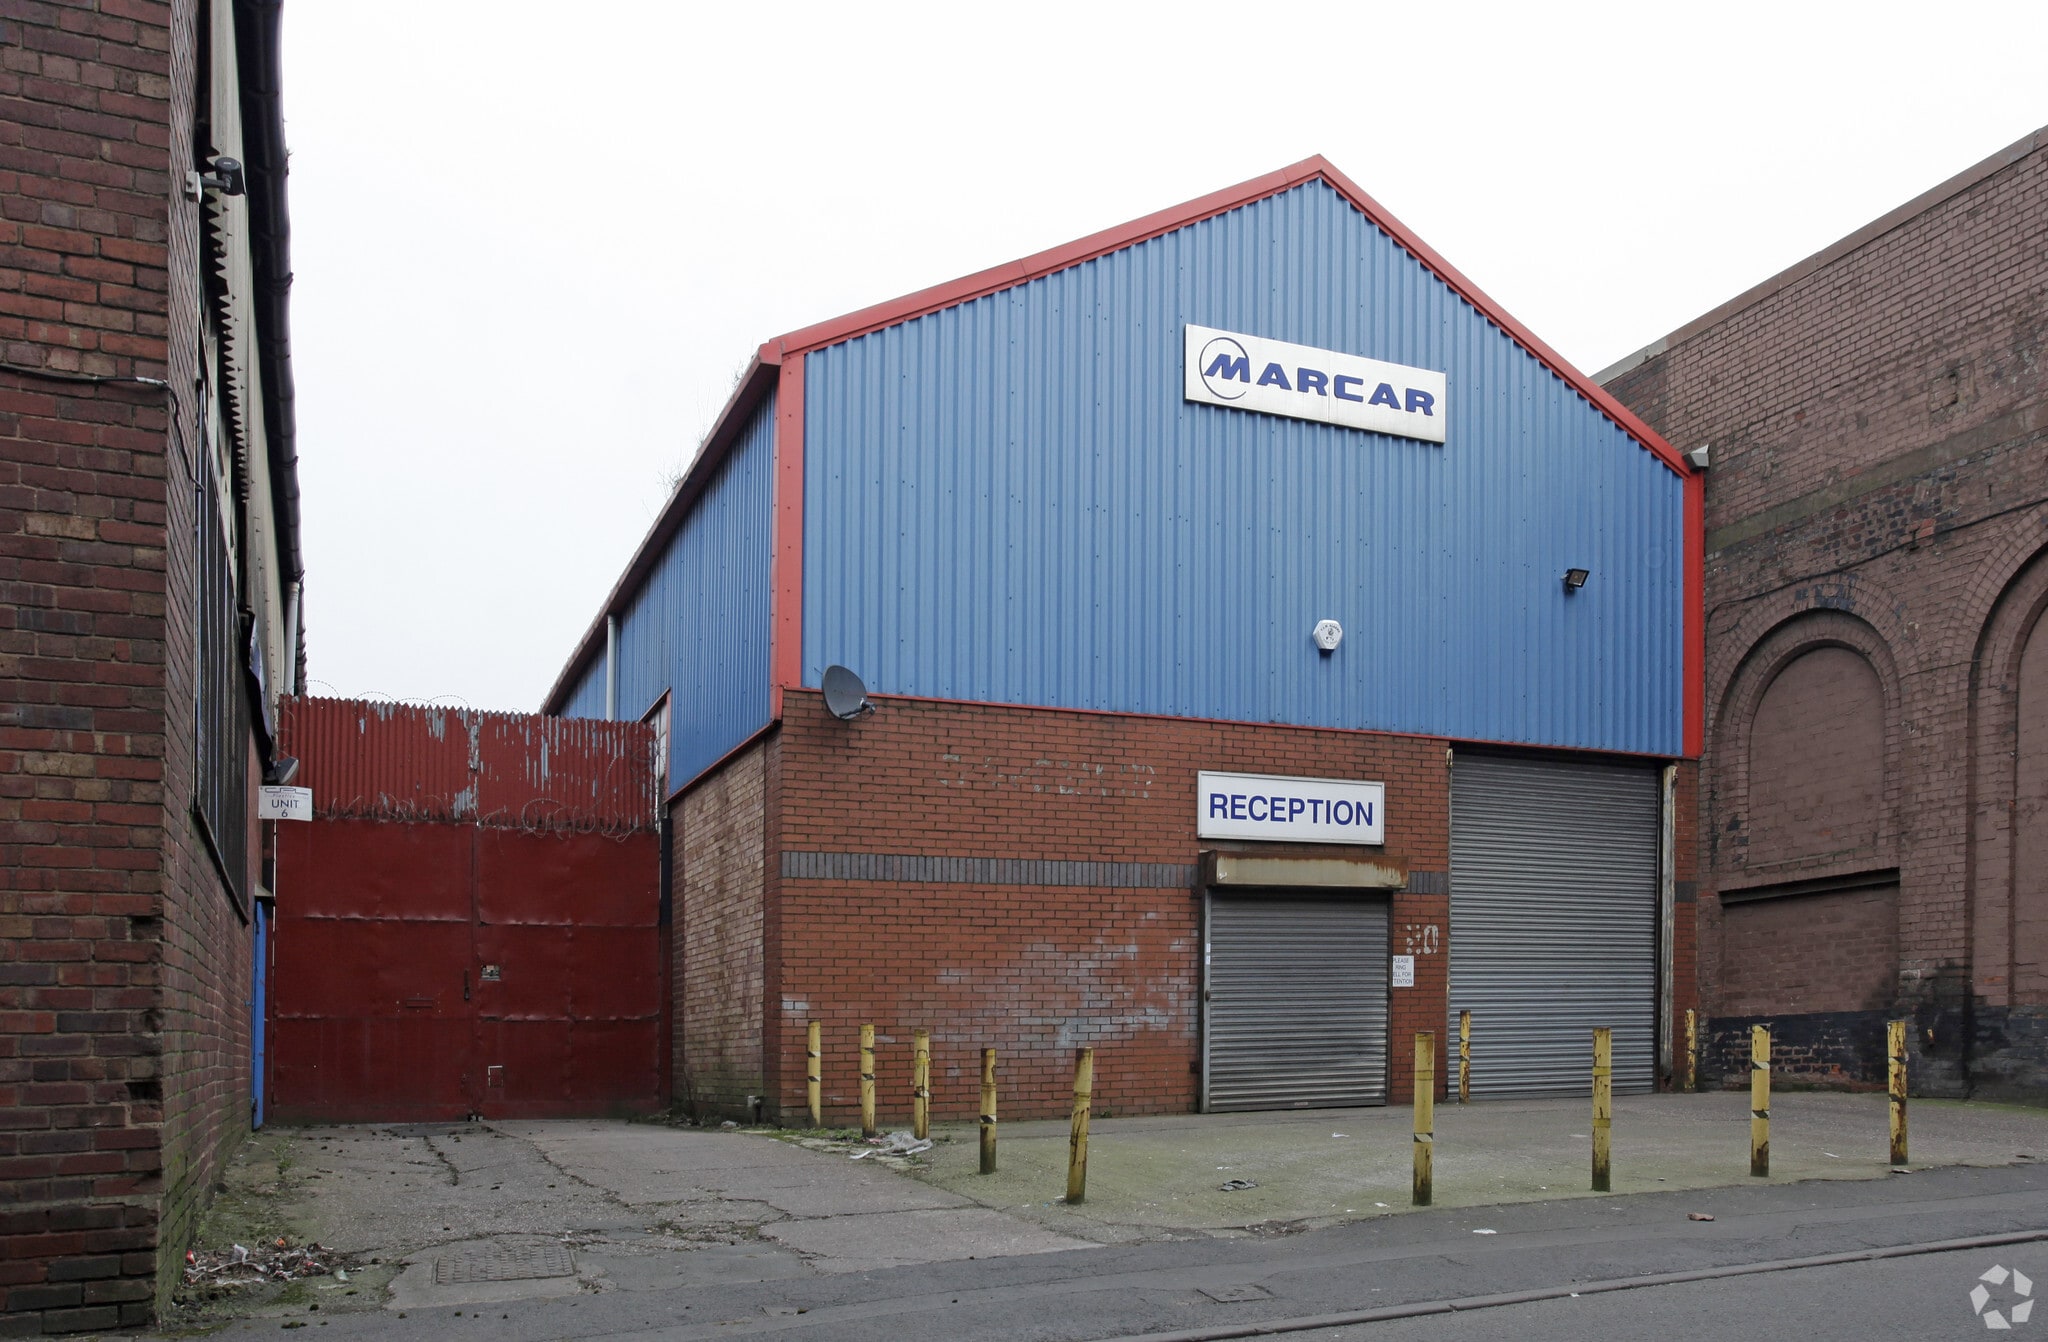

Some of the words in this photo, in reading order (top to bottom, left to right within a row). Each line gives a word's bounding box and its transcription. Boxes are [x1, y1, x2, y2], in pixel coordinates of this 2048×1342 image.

[1203, 352, 1435, 416] MARCAR
[271, 799, 299, 808] UNIT
[281, 808, 288, 818] 6
[1209, 793, 1373, 826] RECEPTION
